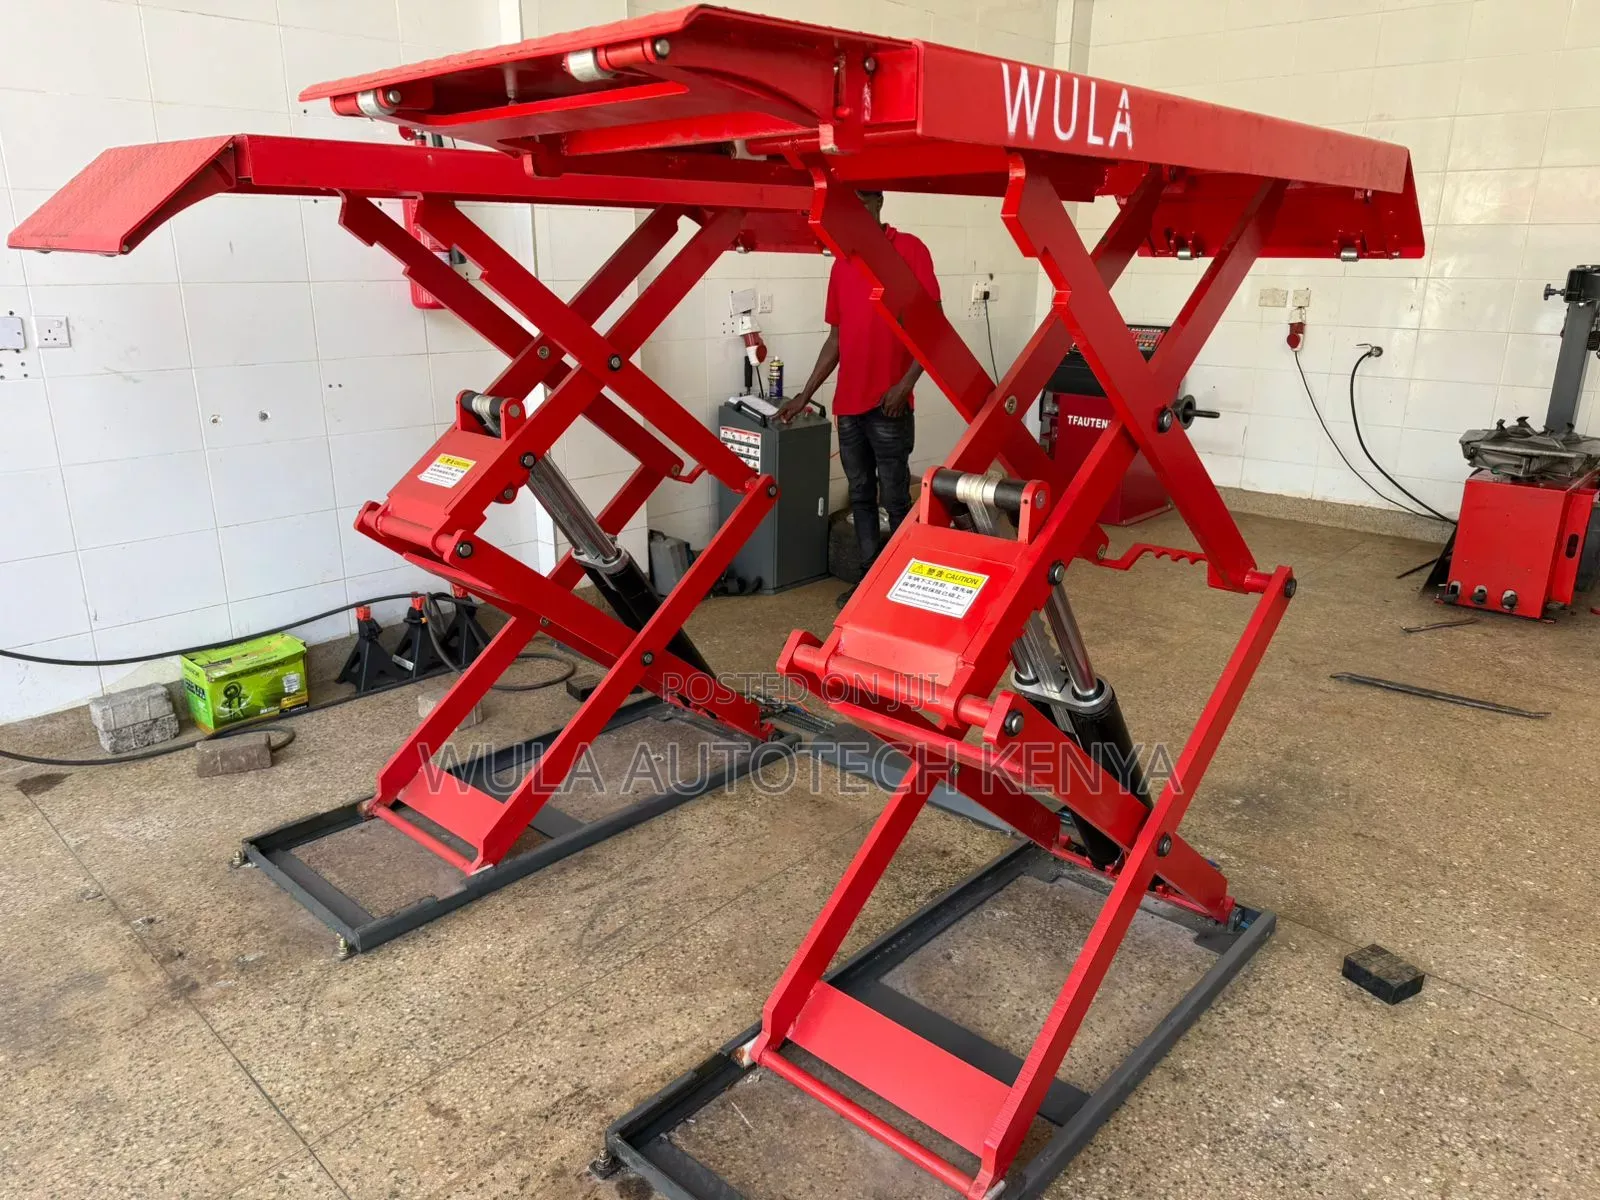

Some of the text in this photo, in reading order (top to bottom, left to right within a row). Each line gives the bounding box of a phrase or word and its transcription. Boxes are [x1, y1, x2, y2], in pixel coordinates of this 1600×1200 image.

[1001, 62, 1133, 149] WULA
[1067, 415, 1111, 429] TFAUTEN
[945, 573, 979, 585] CAUTION
